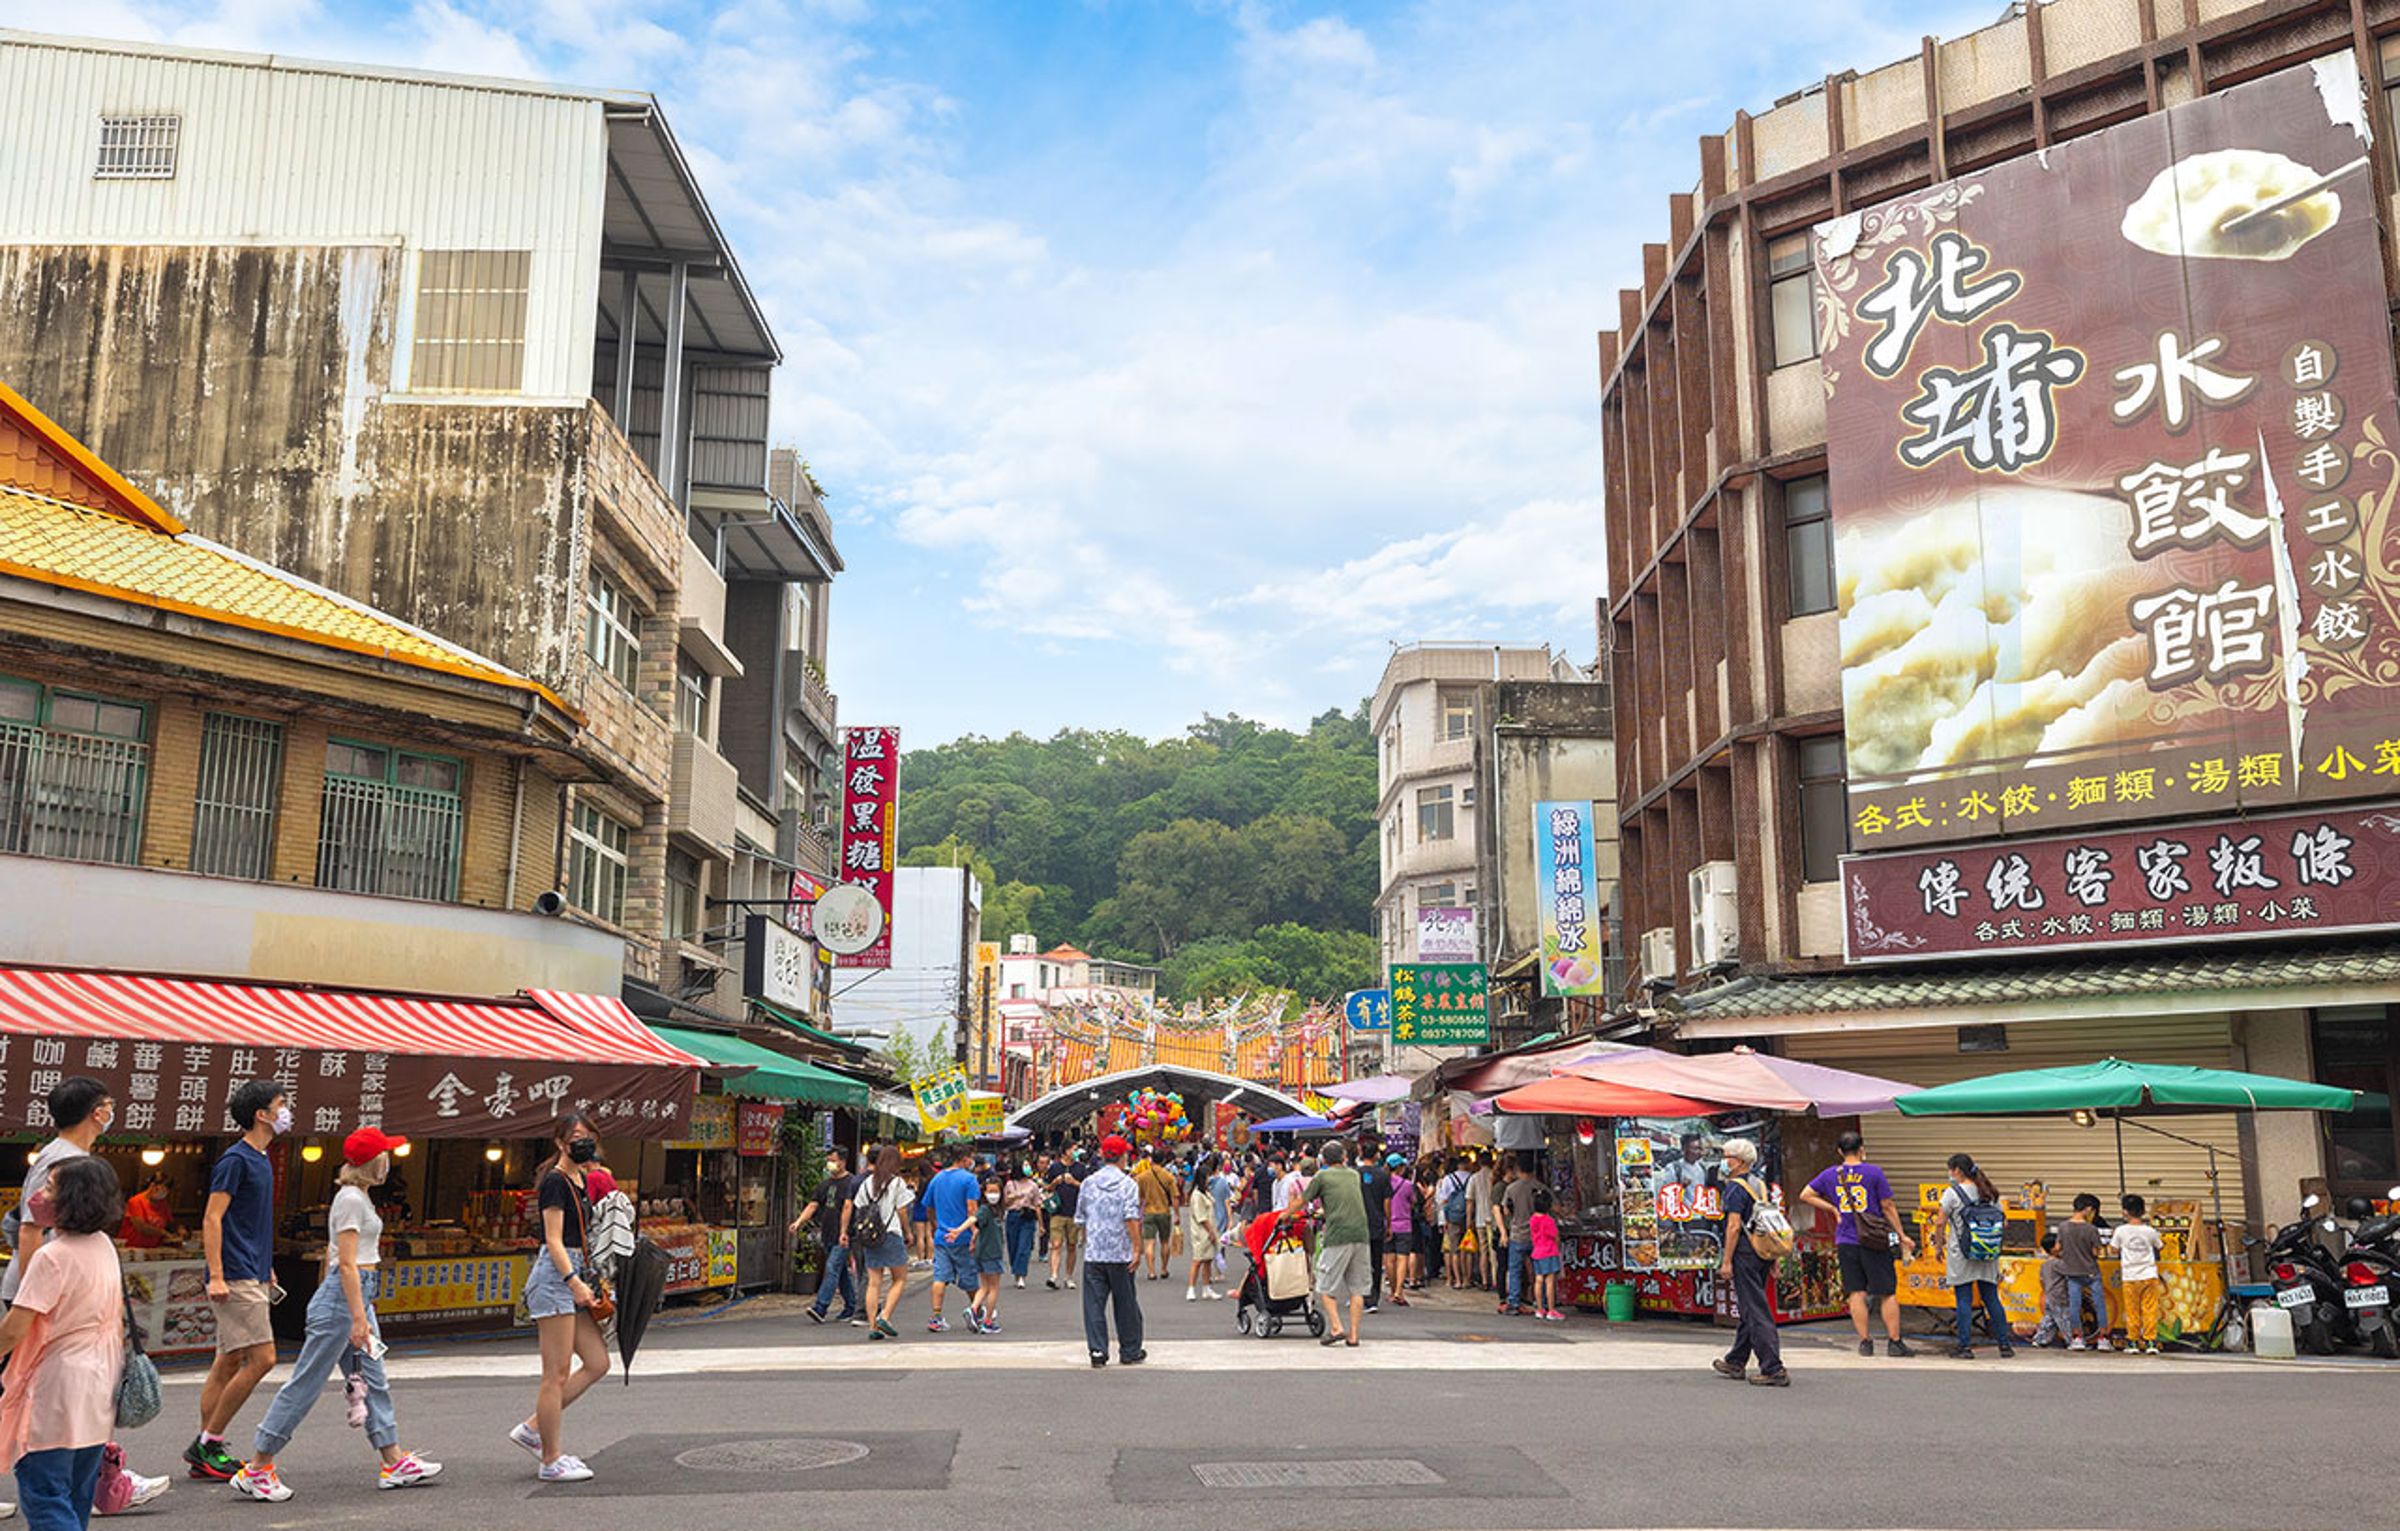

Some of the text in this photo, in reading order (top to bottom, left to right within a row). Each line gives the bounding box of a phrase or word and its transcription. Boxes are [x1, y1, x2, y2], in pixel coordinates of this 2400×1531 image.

[1857, 233, 2085, 472] 北埔
[2113, 332, 2274, 682] 水餃館
[2293, 345, 2367, 642] 自製手工水餃
[1551, 810, 1586, 951] 綠洲綿綿冰
[175, 1046, 212, 1130] 芋頭餅
[314, 1052, 347, 1132] 酥餅
[1835, 1185, 1868, 1213] 23
